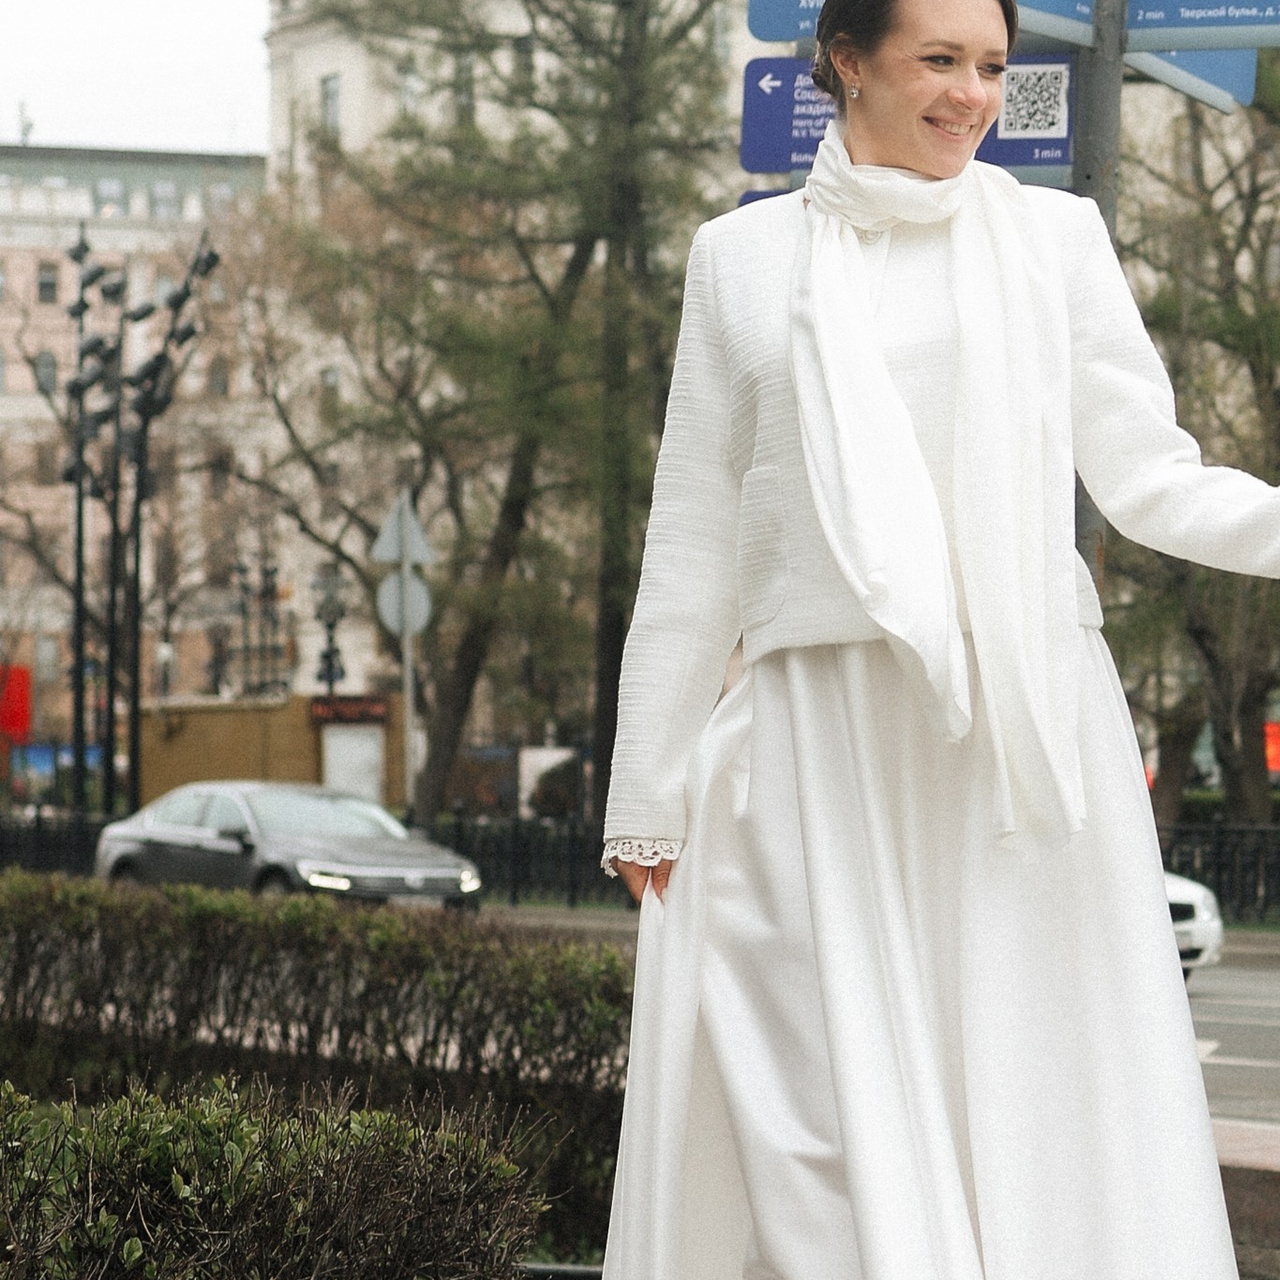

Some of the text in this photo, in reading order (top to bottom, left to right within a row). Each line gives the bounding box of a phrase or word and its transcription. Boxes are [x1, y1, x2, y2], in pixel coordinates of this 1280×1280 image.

[1137, 9, 1165, 20] 2 min
[1180, 6, 1227, 20] Тверской
[1033, 147, 1062, 159] 3 min
